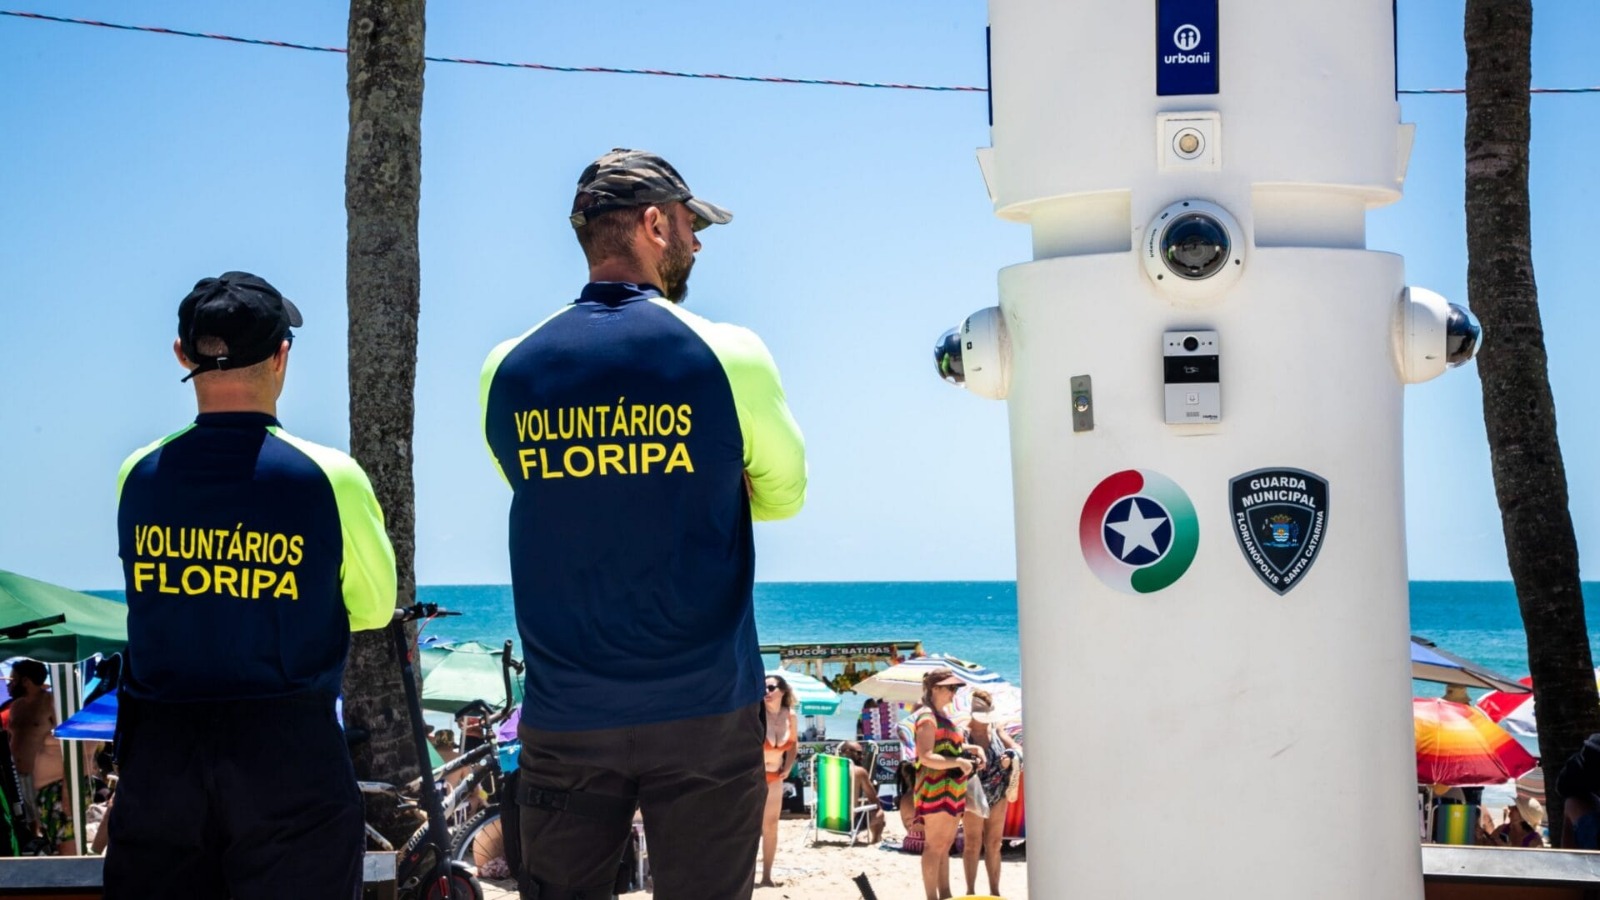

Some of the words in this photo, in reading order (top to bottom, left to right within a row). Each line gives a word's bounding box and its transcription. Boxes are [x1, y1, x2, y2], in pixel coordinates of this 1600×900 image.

[1164, 52, 1210, 64] urbanii
[514, 396, 692, 443] VOLUNTÁRIOS
[518, 442, 695, 480] FLORIPA
[1241, 490, 1316, 508] MUNICIPAL
[1250, 477, 1307, 490] GUARDA
[135, 522, 304, 566] VOLUNTÁRIOS
[1236, 512, 1280, 584] FLORIANÓPOLIS
[1283, 557, 1308, 584] SANTA
[1305, 510, 1324, 557] CATARINA
[134, 562, 298, 601] FLORIPA
[787, 648, 827, 656] SUCOS
[841, 647, 890, 655] BATIDAS
[870, 744, 899, 752] Futas
